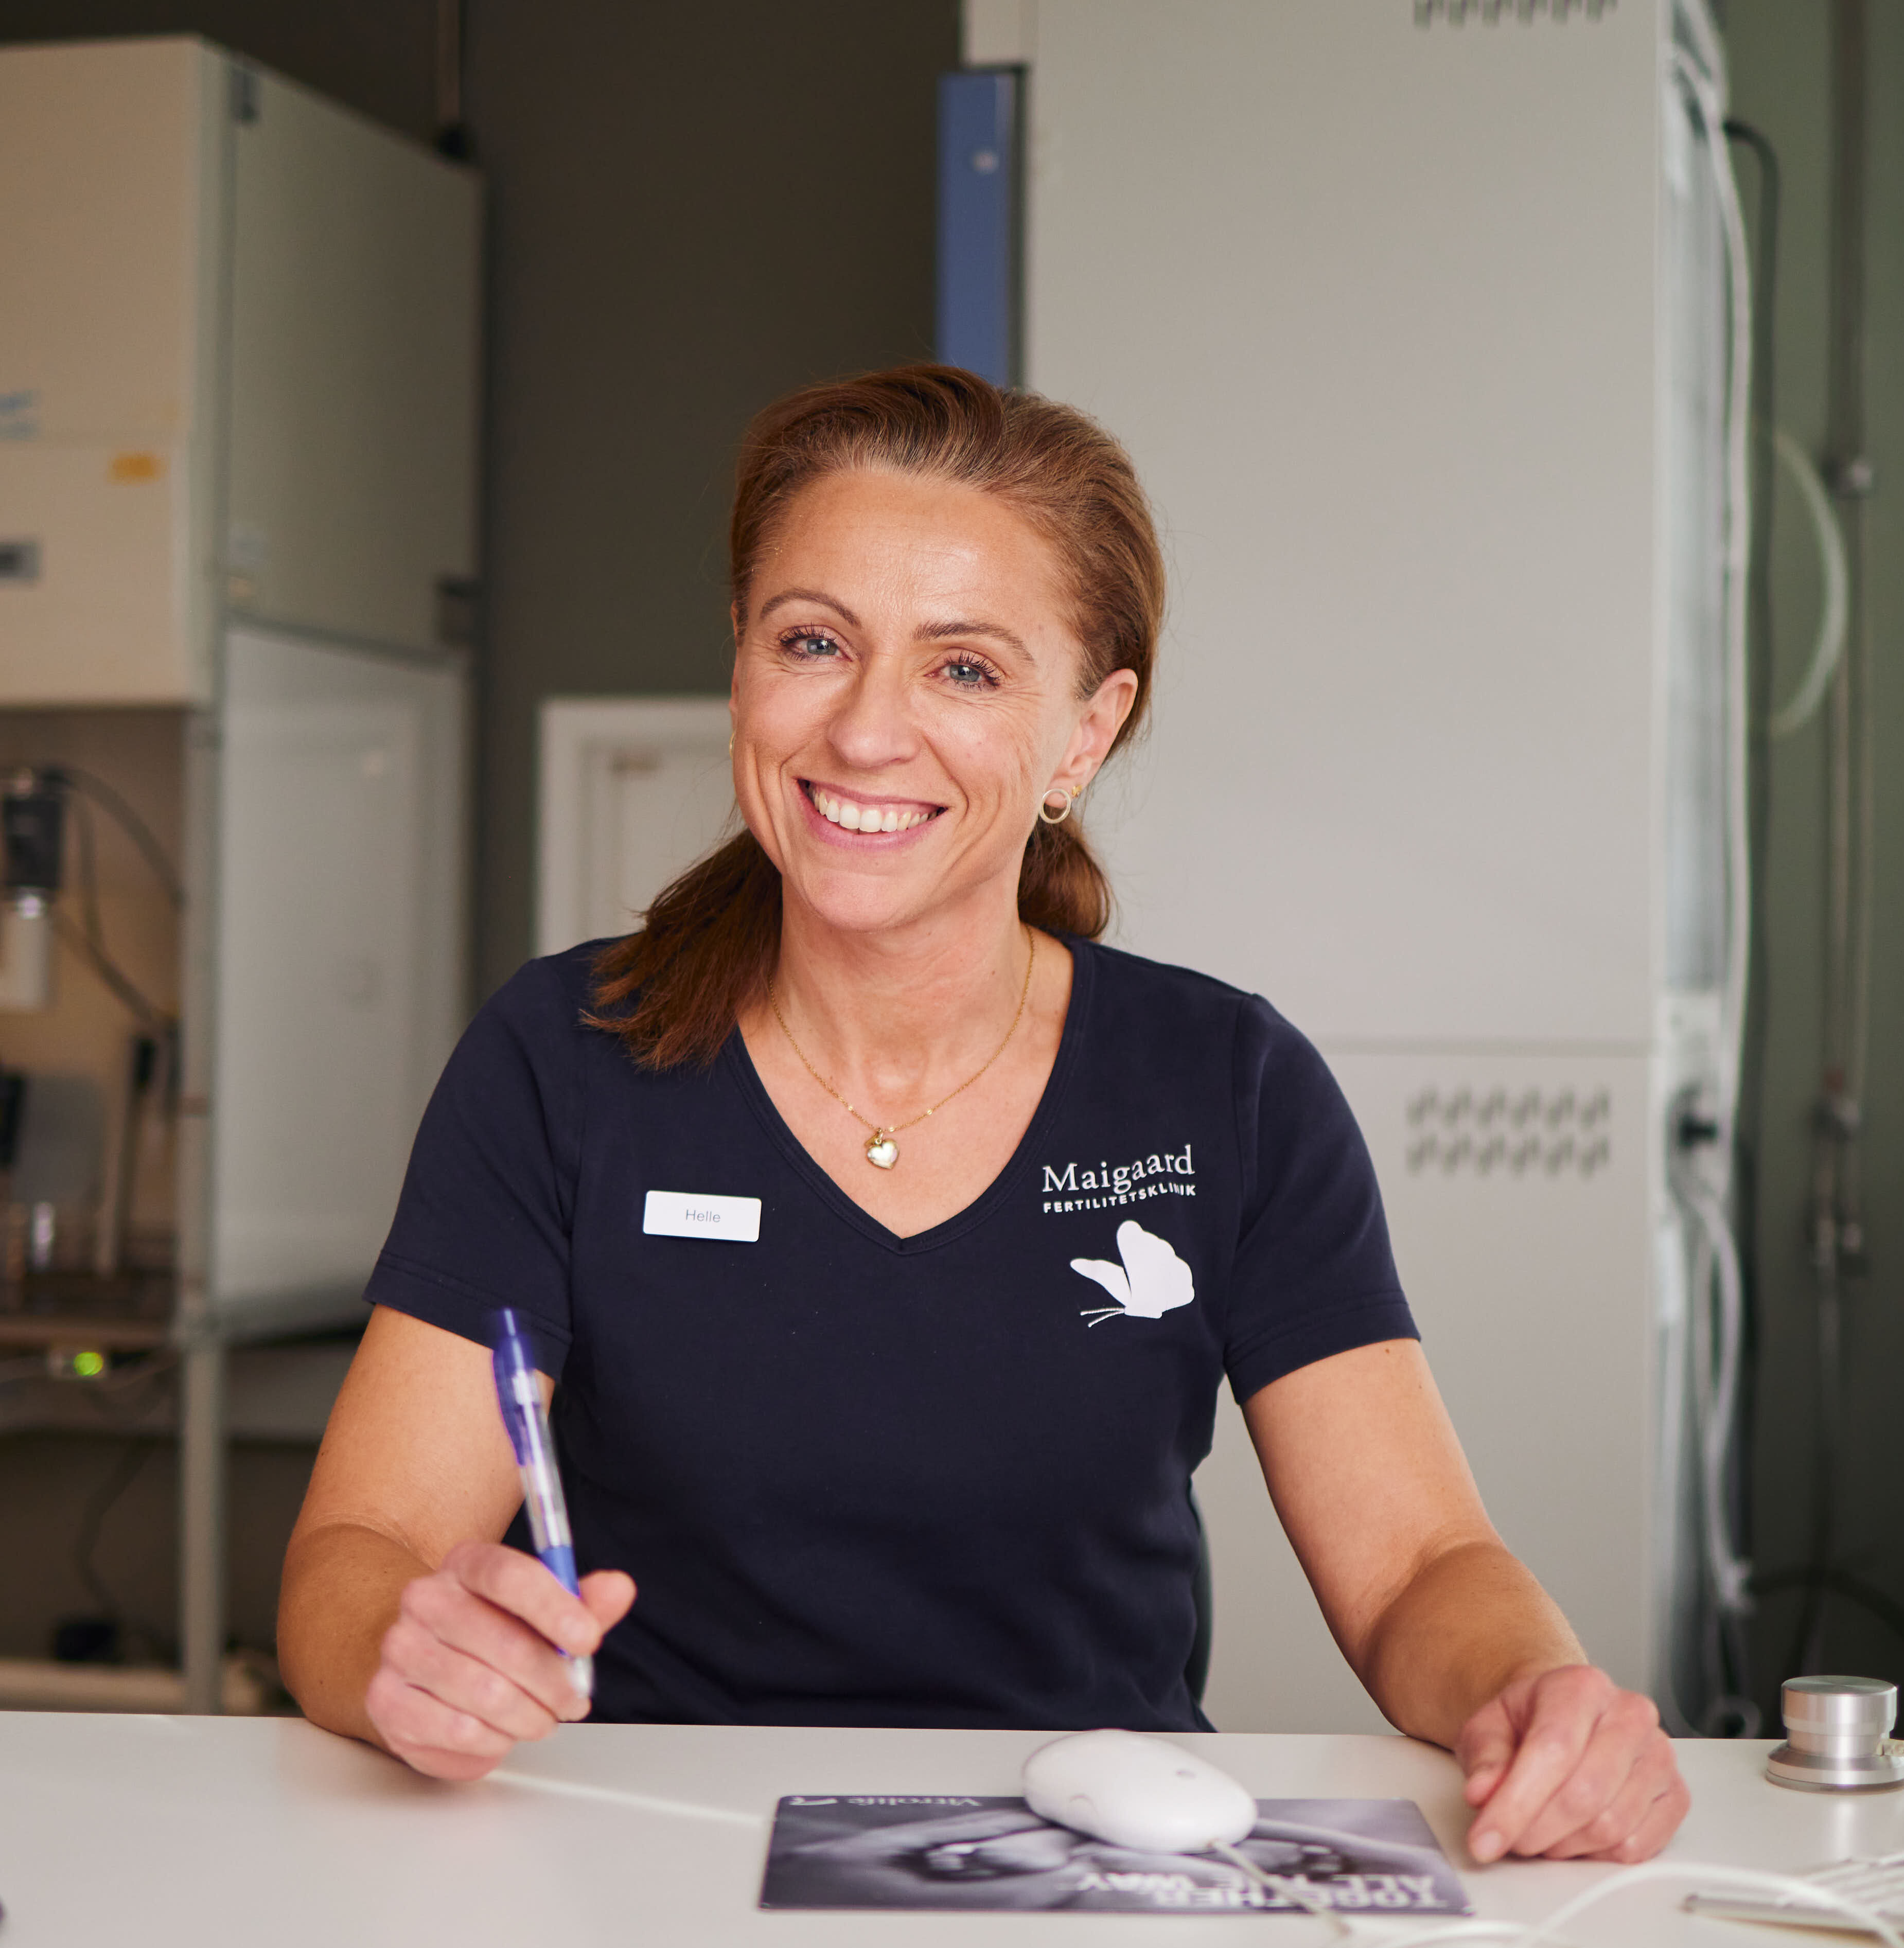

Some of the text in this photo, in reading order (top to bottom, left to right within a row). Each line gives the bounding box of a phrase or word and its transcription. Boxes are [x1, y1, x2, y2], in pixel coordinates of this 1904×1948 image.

[1042, 1144, 1195, 1195] Maigaard
[1043, 1182, 1196, 1213] FERTILITETSKLINIK
[685, 1209, 720, 1223] Helle
